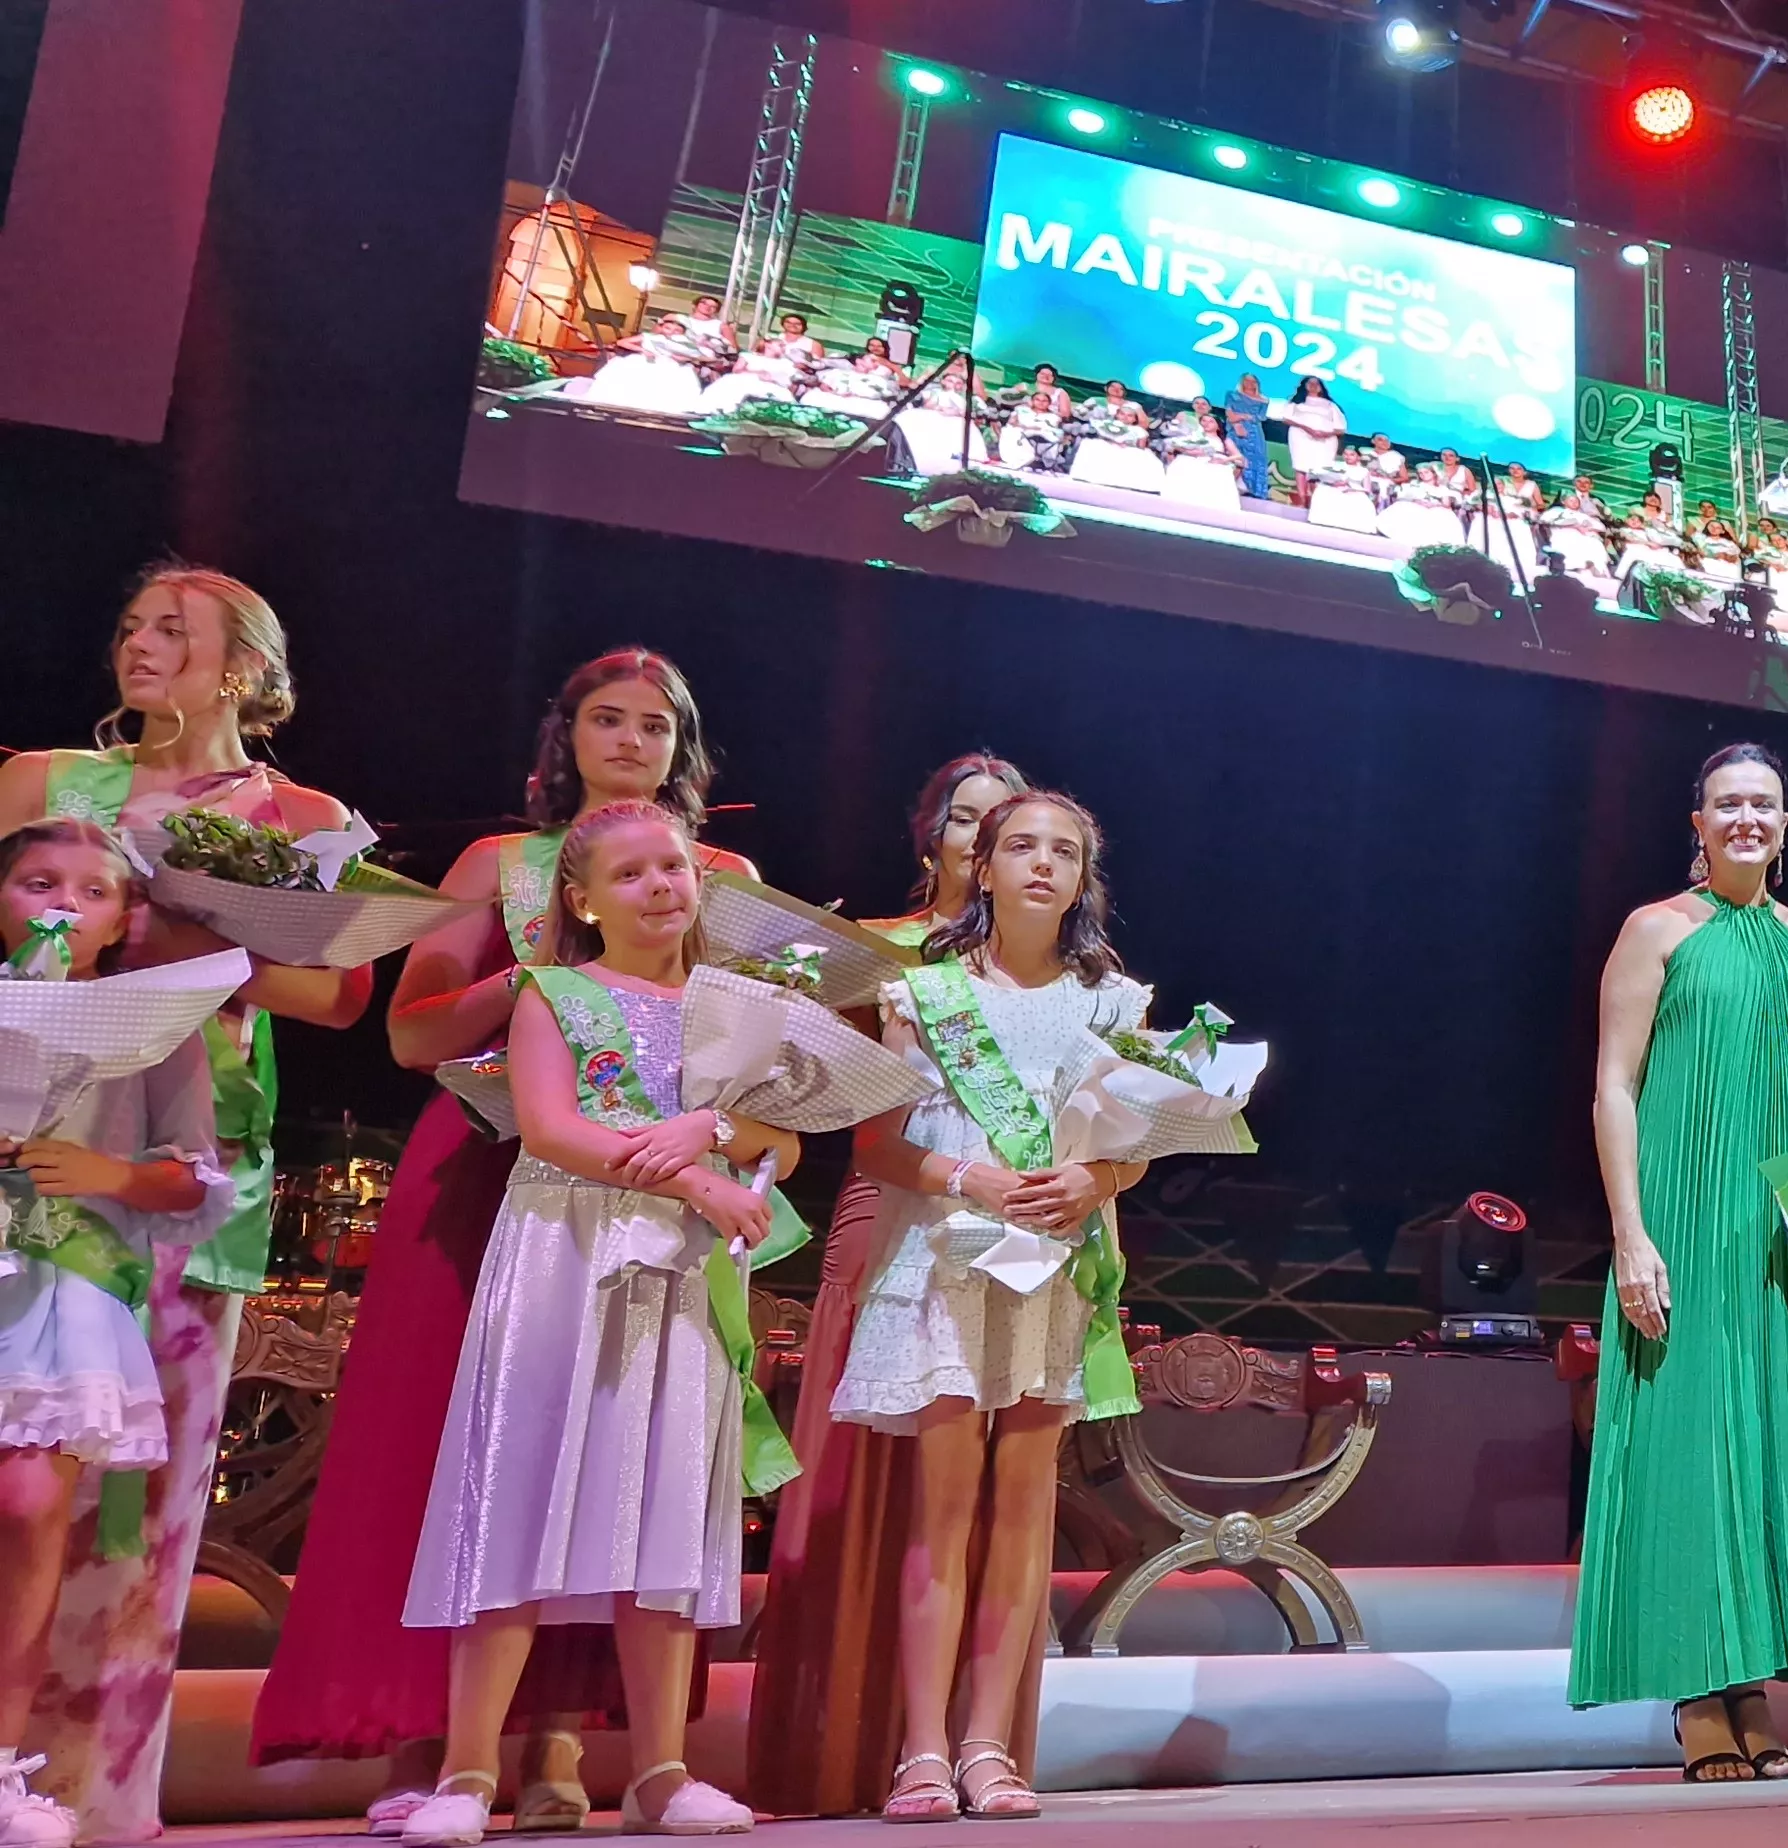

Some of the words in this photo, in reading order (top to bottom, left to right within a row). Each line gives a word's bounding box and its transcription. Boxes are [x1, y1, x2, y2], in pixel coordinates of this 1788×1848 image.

[1147, 216, 1437, 302] PRESENTACIÓN
[996, 212, 1565, 393] MAIRALESAS
[1191, 311, 1385, 392] 2024
